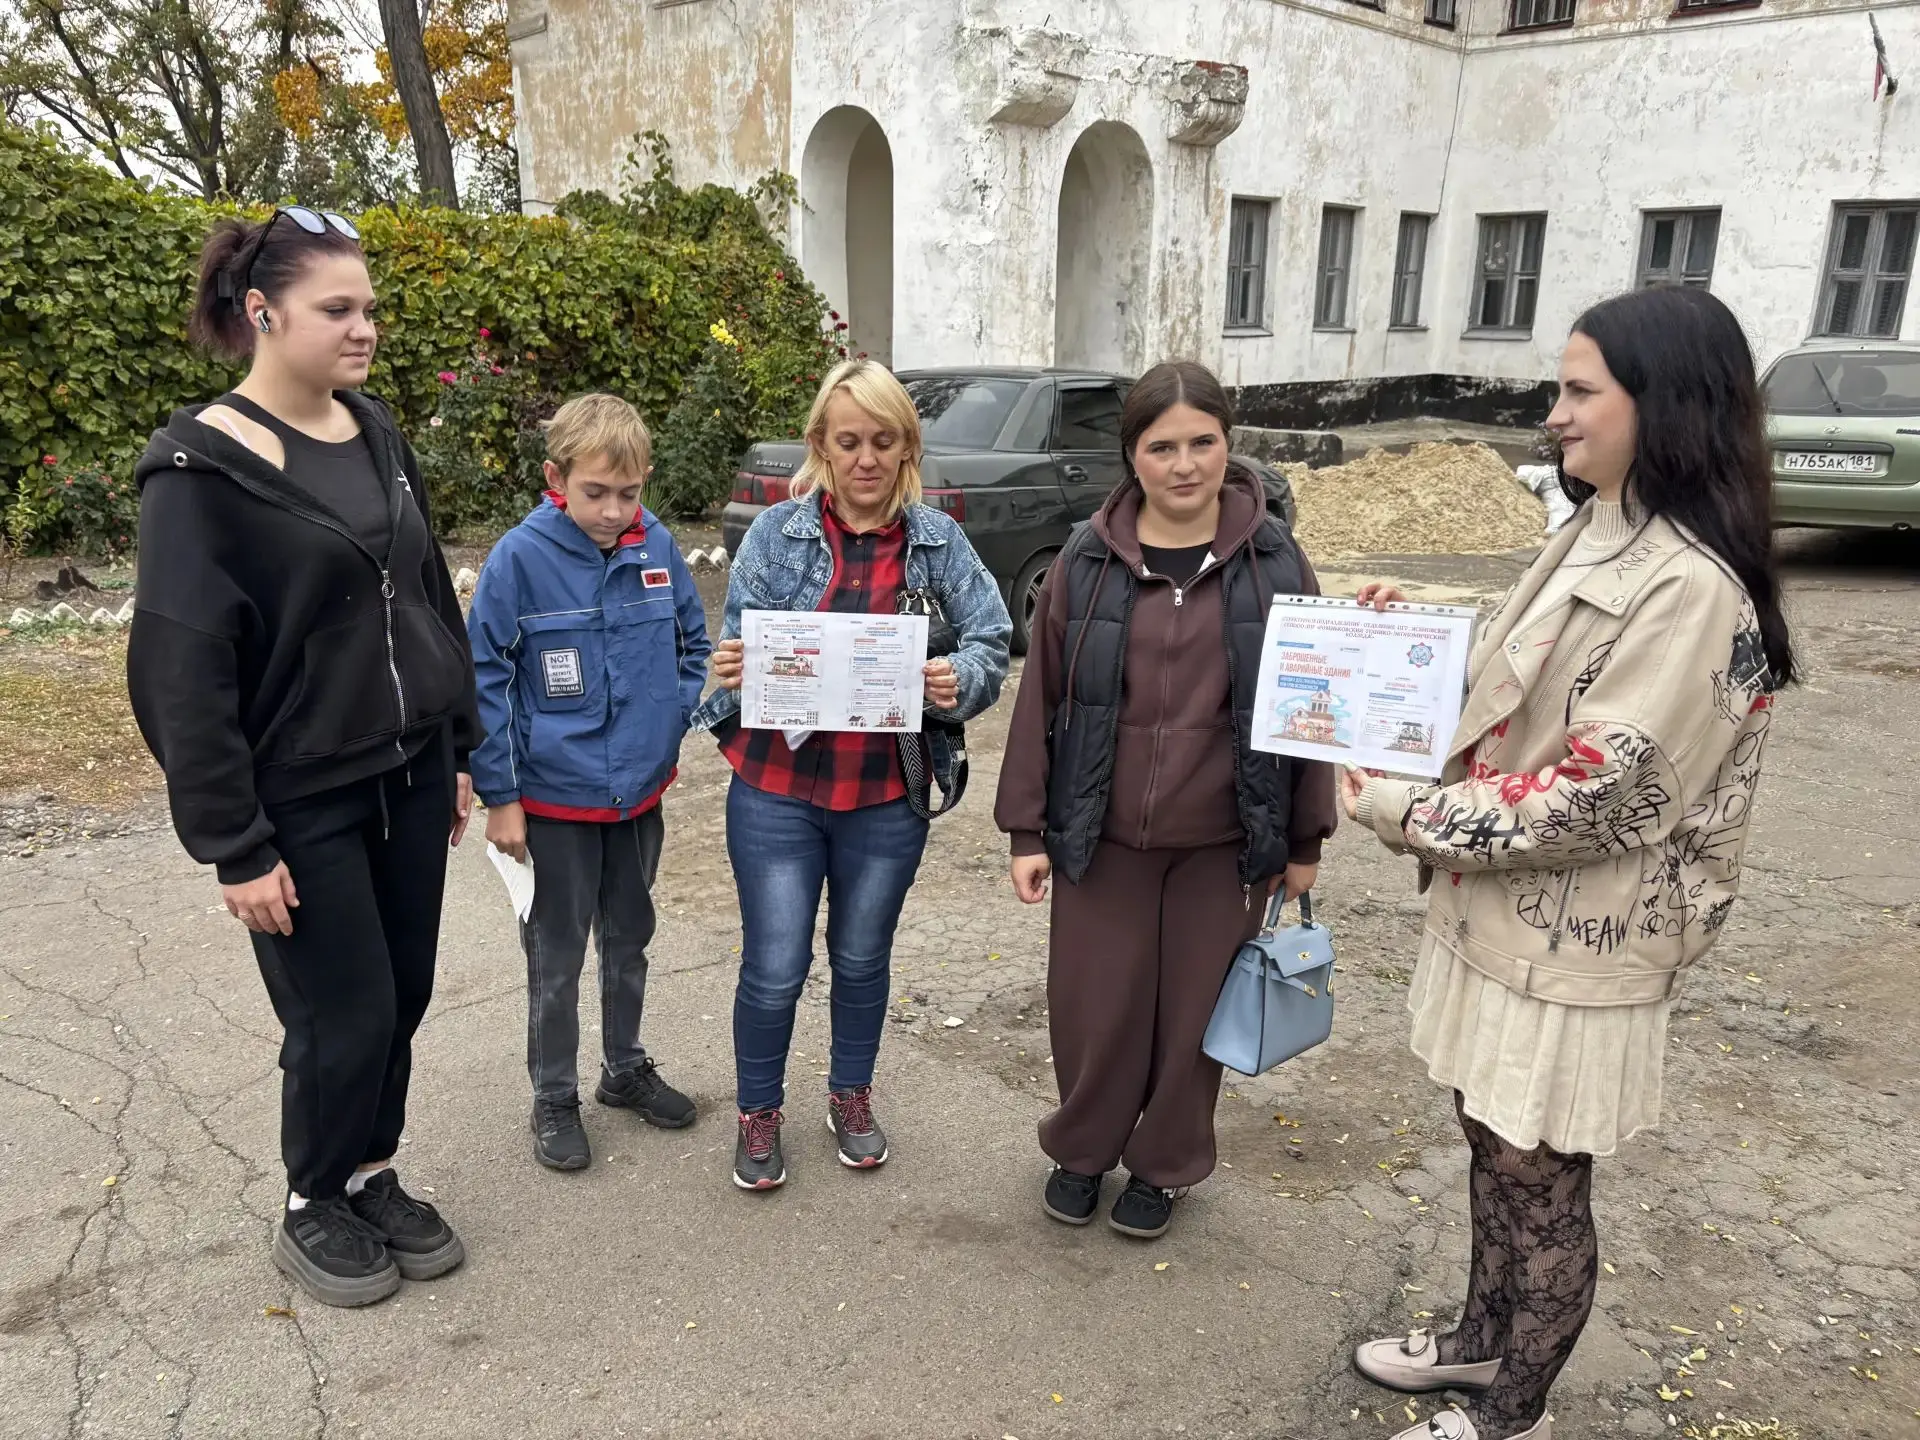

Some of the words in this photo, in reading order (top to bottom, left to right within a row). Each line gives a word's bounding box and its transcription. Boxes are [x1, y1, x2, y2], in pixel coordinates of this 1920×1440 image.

[1850, 455, 1873, 466] 181
[549, 654, 569, 664] NOT
[1281, 651, 1328, 664] ЗАБРОШЕННЫЕ
[1285, 663, 1324, 676] АВАРИЙНЫЕ
[1324, 667, 1352, 679] ЗДАНИЯ
